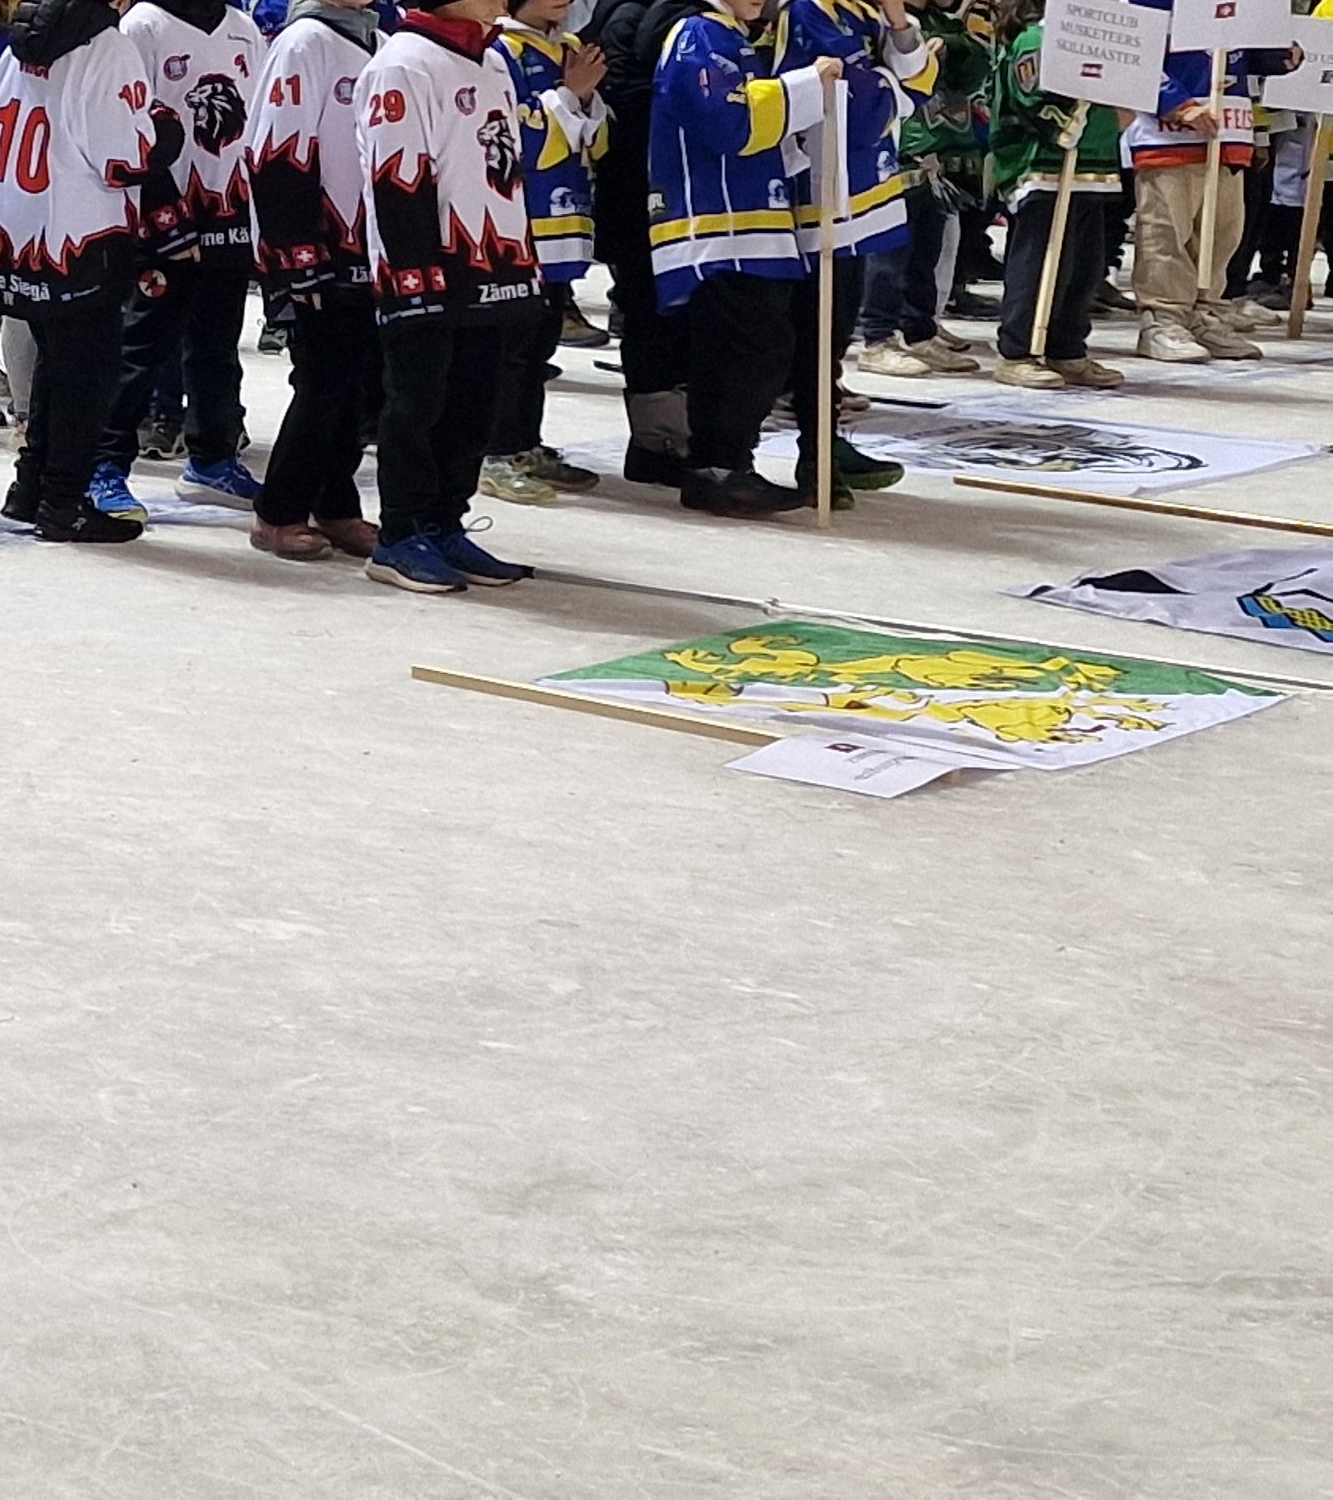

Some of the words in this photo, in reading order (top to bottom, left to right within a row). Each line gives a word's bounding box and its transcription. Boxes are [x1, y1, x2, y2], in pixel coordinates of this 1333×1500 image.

[1066, 3, 1139, 29] SPORTCLUB
[1060, 20, 1141, 48] MUSKETEERS
[1055, 38, 1141, 66] SKILLMASTER
[118, 80, 147, 115] 10
[269, 74, 302, 107] 41
[368, 88, 407, 127] 29
[478, 282, 530, 304] Zäme
